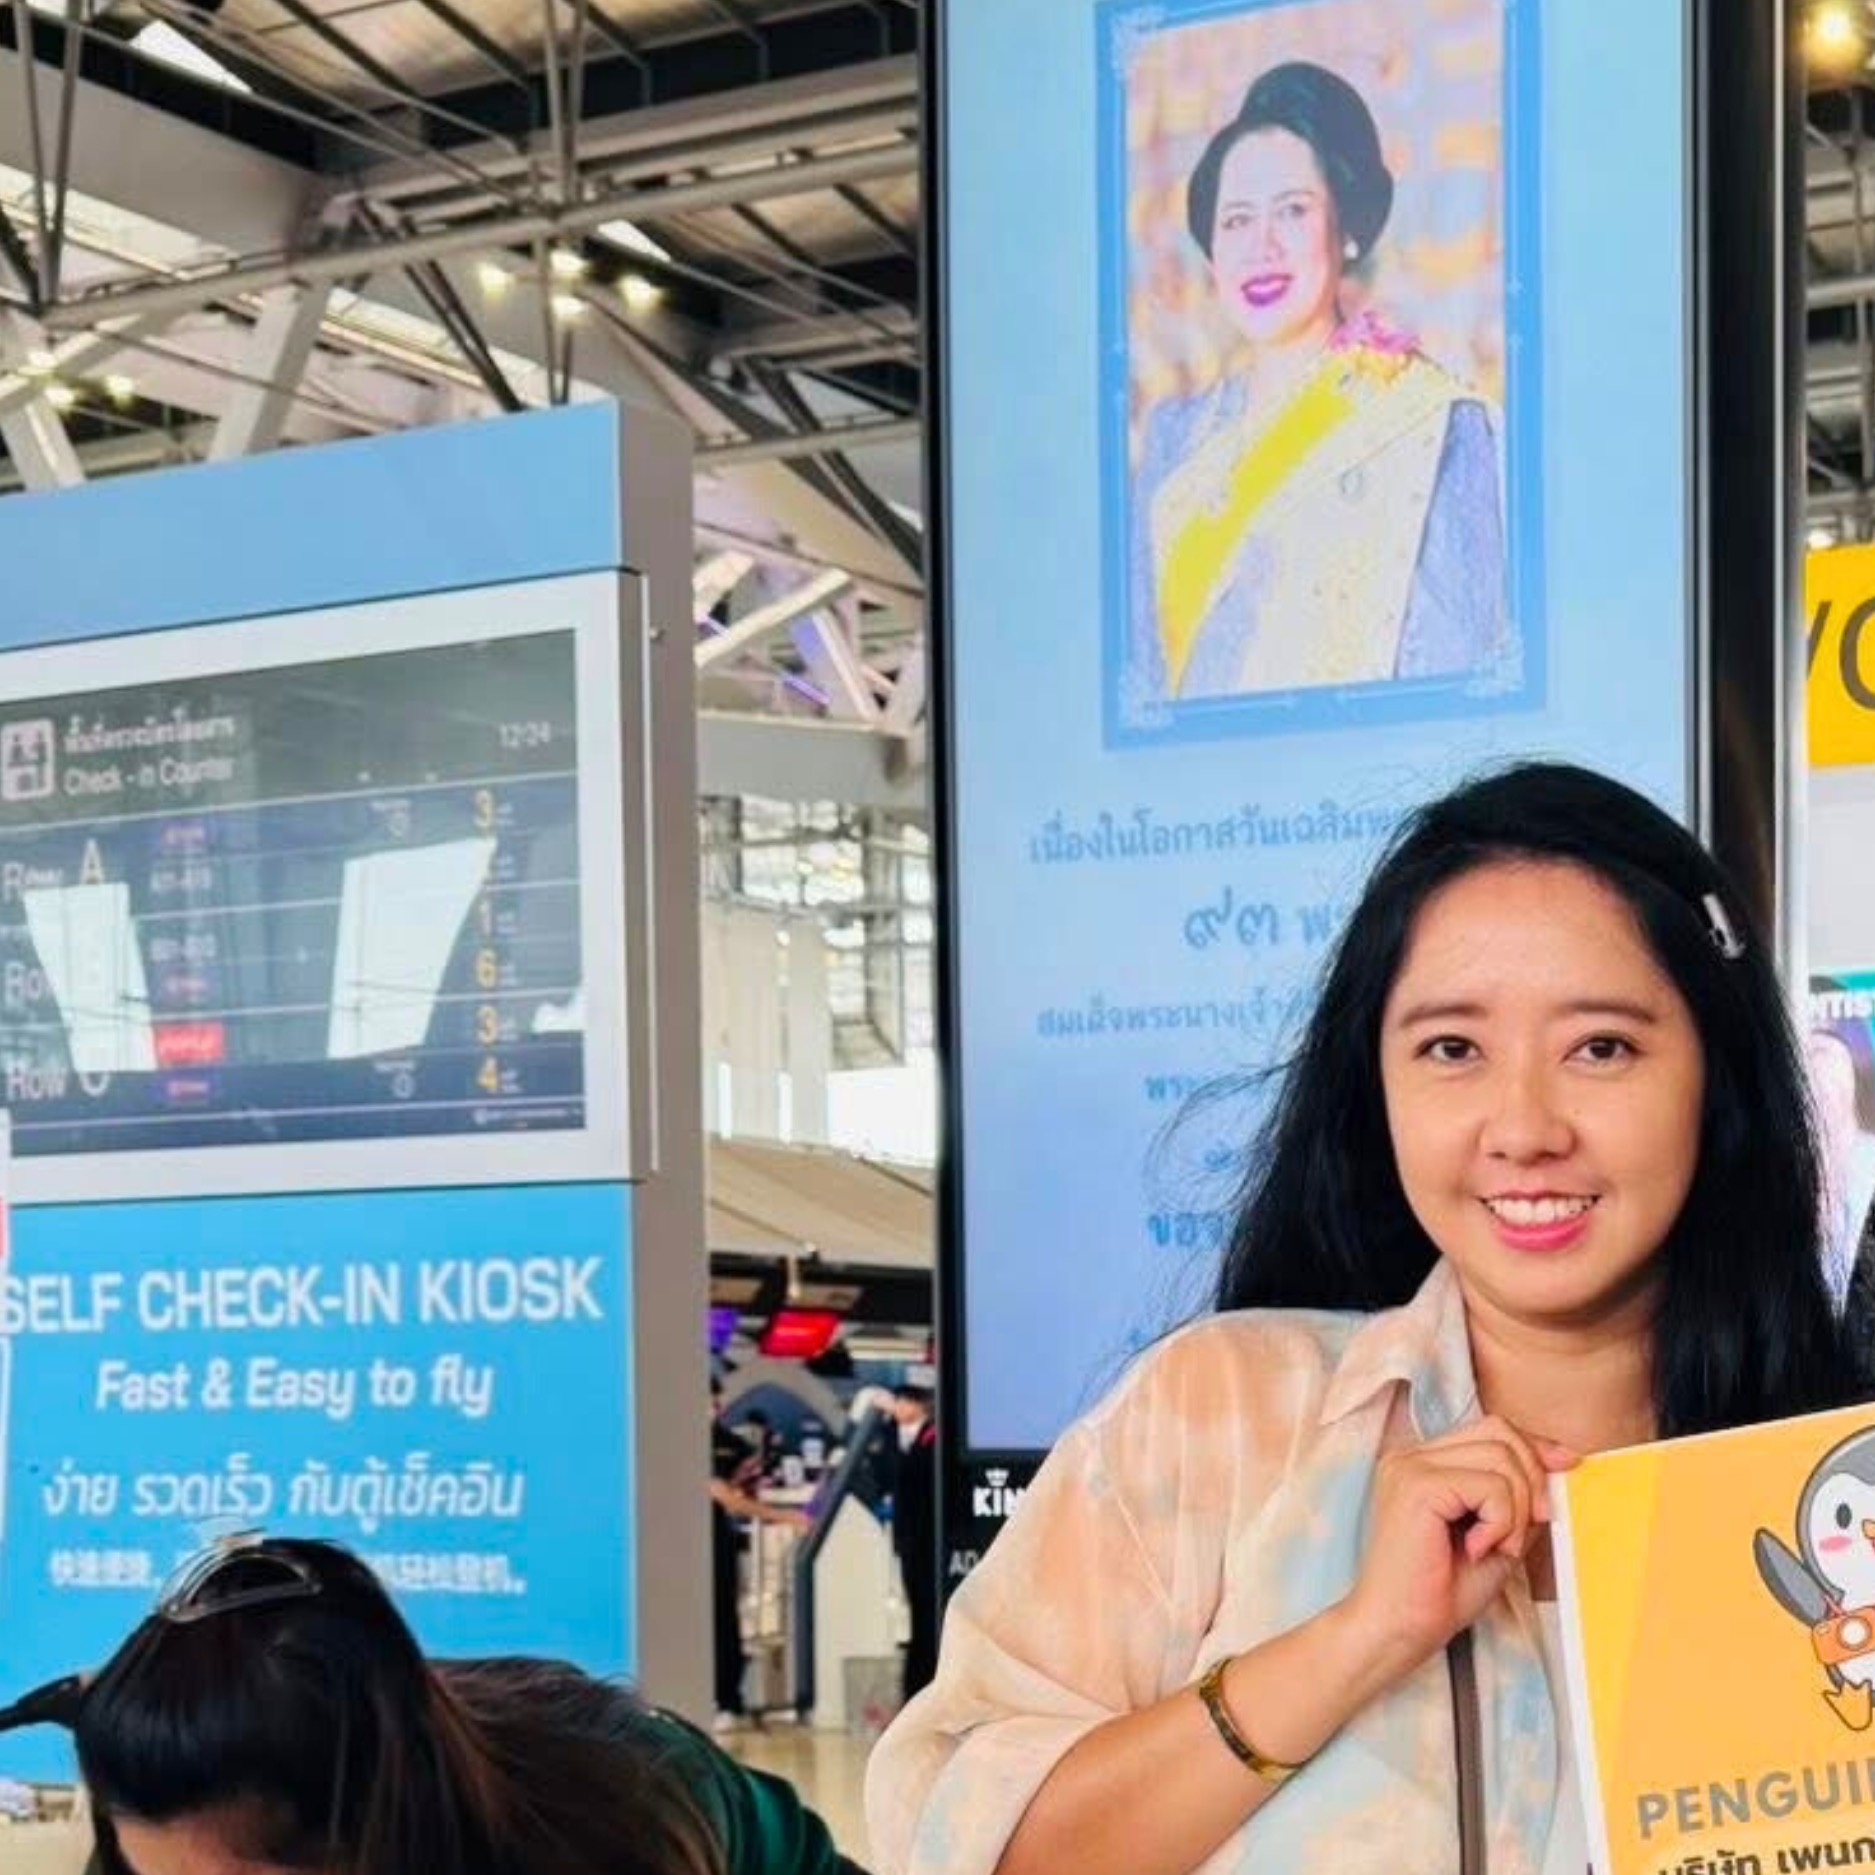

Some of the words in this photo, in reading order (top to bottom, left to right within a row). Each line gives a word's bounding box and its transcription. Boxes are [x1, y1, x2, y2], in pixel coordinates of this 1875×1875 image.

[0, 1272, 123, 1335] SELF
[138, 1261, 402, 1330] CHECK-IN
[419, 1254, 604, 1324] KIOSK
[96, 1359, 190, 1411] Fast
[202, 1356, 231, 1408] &
[246, 1356, 355, 1420] Easy
[370, 1358, 414, 1408] to
[431, 1353, 494, 1419] fly
[43, 1458, 118, 1517] ง่าย
[132, 1450, 273, 1517] รวดเร็ว
[289, 1450, 525, 1534] กับตู้เช็คอิน
[972, 1487, 1028, 1518] KIN
